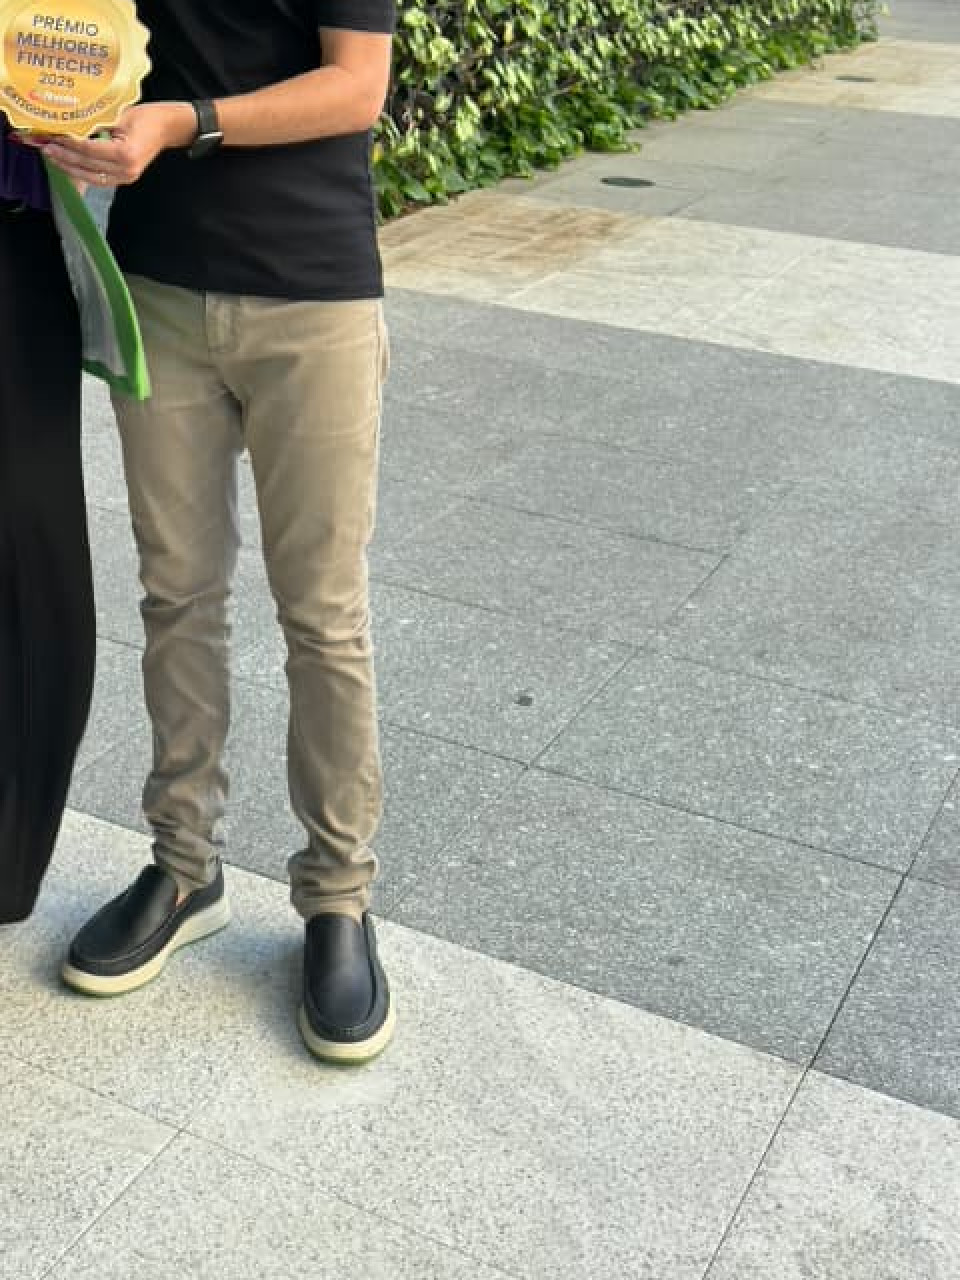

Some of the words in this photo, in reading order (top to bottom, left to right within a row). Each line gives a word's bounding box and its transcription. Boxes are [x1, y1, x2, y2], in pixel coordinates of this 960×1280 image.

[16, 31, 109, 59] MELHORES
[16, 51, 103, 77] FINTECHS
[38, 72, 75, 89] 2025
